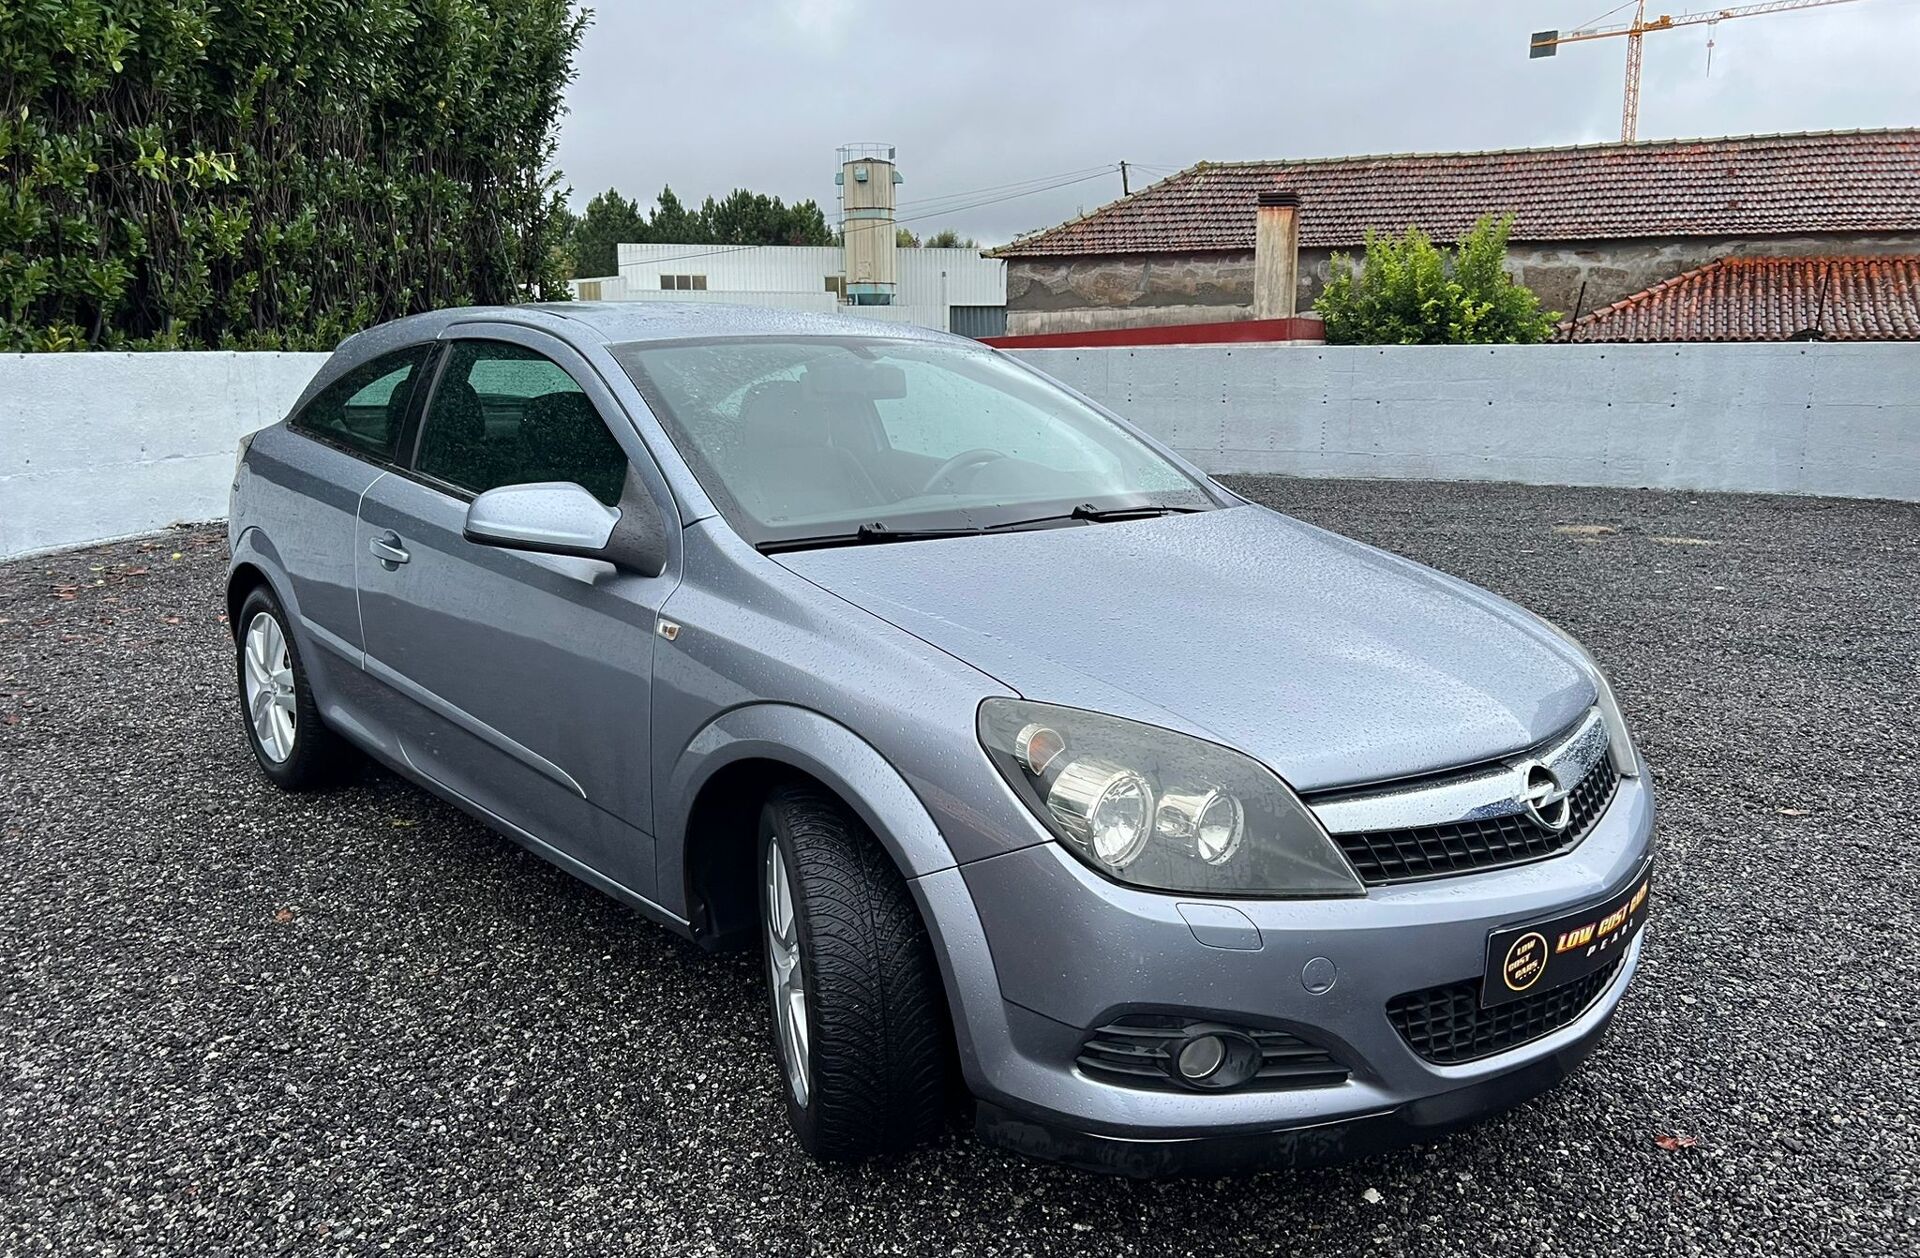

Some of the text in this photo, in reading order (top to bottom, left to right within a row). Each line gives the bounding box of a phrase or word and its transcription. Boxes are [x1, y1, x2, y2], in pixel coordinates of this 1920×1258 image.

[1556, 879, 1648, 954] LOW COST CAR
[1517, 939, 1537, 956] LOW
[1508, 952, 1531, 972] COST
[1515, 959, 1538, 980] CARS
